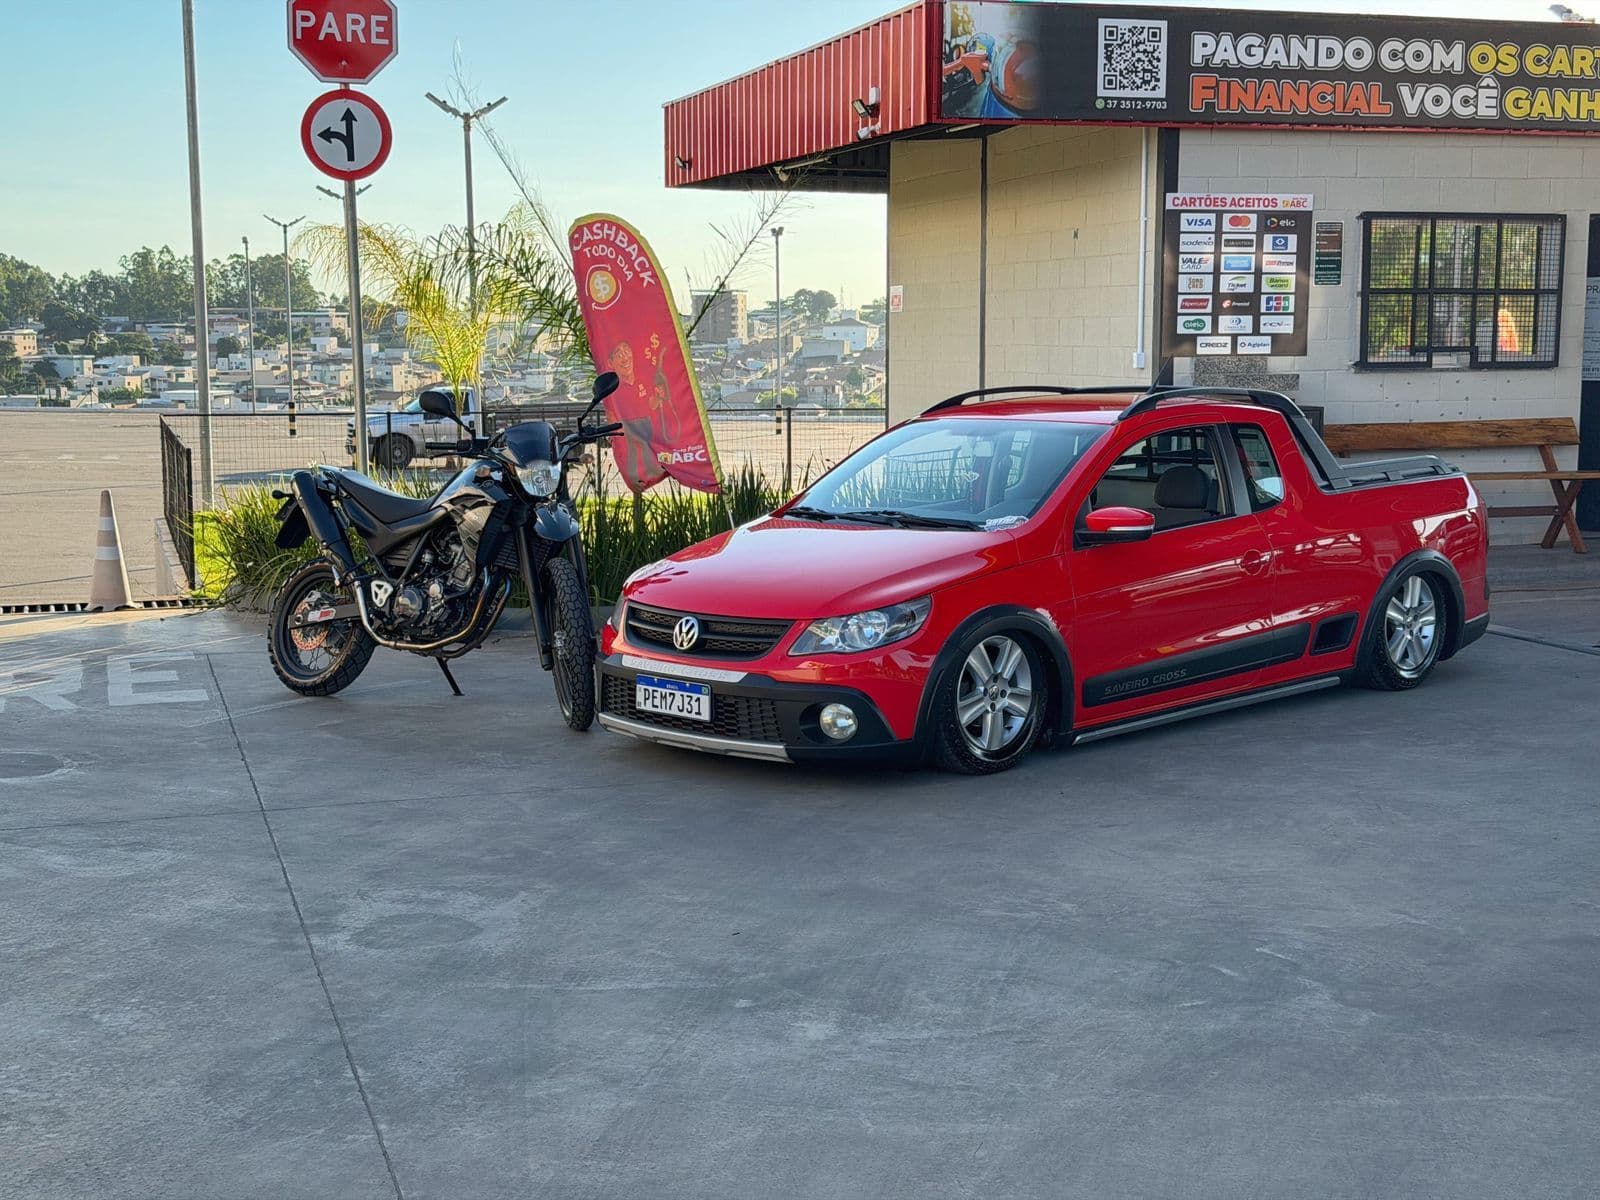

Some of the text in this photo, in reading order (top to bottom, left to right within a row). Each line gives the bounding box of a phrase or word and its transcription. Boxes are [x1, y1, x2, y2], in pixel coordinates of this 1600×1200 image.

[295, 9, 390, 45] PARE
[1192, 32, 1600, 78] PAGANDO COM OS CAR
[1106, 100, 1167, 109] 37 3512-9703
[1397, 75, 1499, 118] VOCÊ
[1502, 86, 1600, 121] GANH
[1172, 194, 1278, 208] CARTÕES ACEITOS
[1290, 200, 1308, 208] ABC
[1186, 218, 1212, 227] VISA
[573, 222, 656, 288] CASHBACK
[583, 244, 633, 281] TODO DIA
[1586, 285, 1600, 294] PR
[672, 449, 707, 464] ABC
[1104, 669, 1188, 695] SAVEIRO CROSS
[643, 687, 702, 715] PEM7J31
